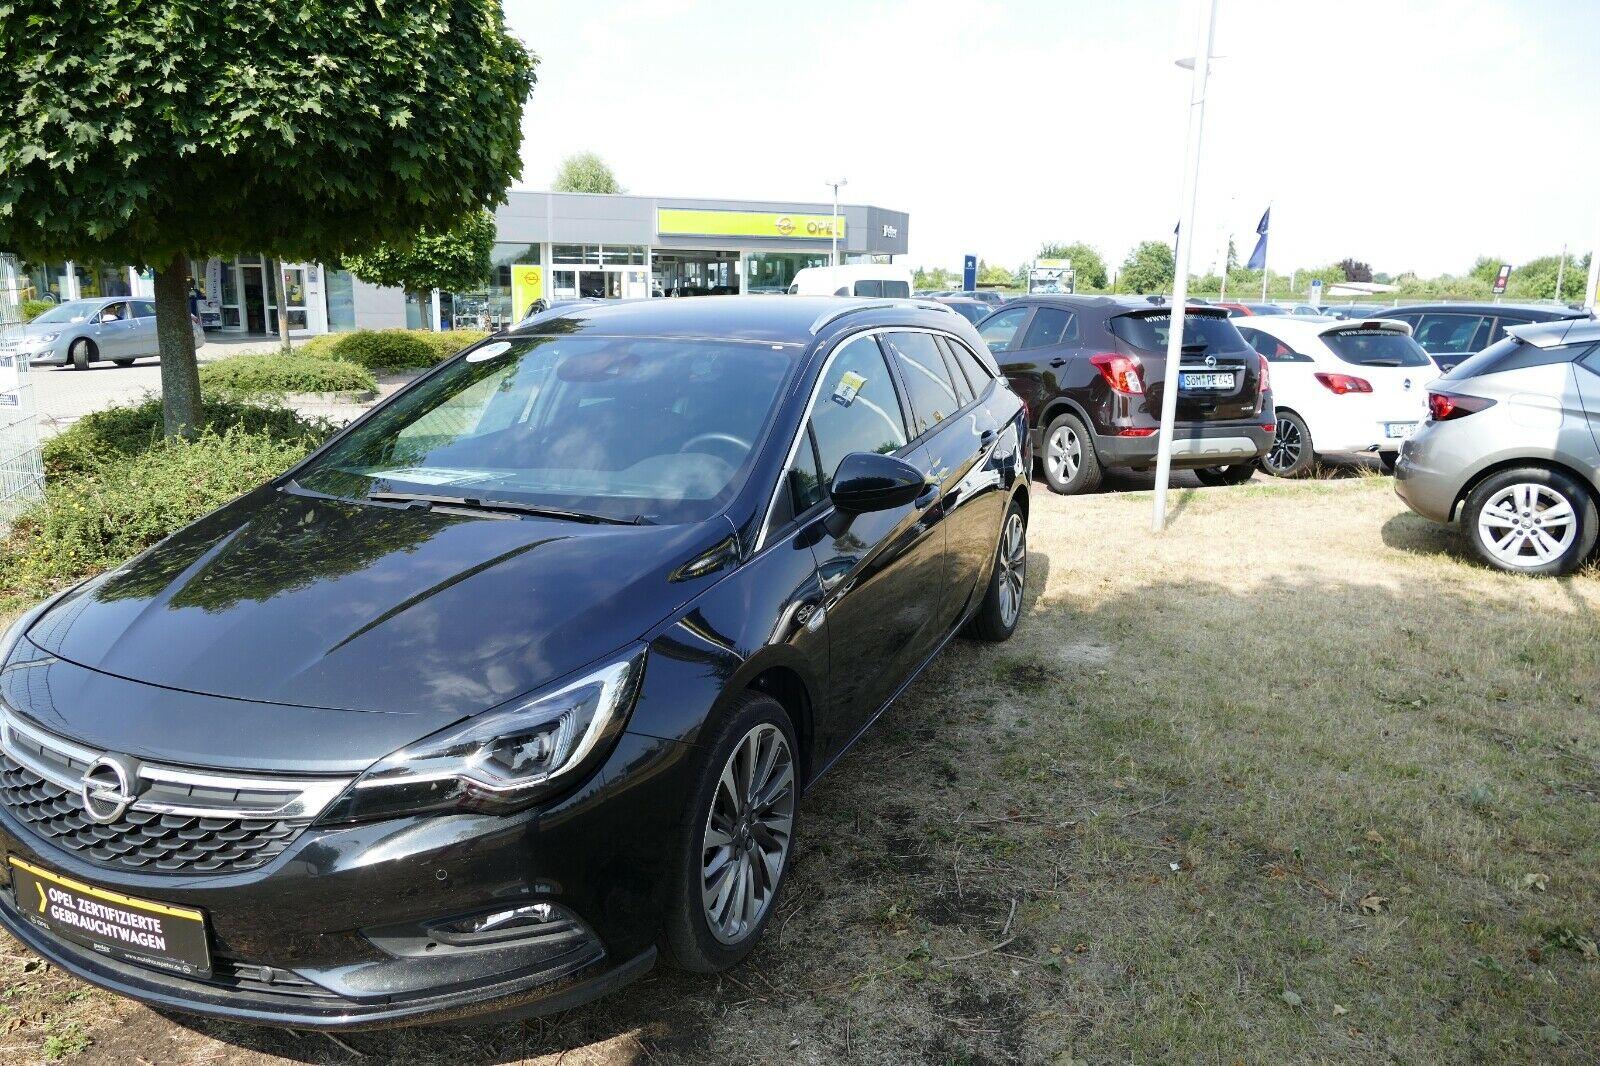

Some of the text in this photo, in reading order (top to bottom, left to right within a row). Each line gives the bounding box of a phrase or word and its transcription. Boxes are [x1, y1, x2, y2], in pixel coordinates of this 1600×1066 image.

[1207, 373, 1217, 386] PE
[49, 888, 162, 933] OPEL ZERTIFIZIERTE
[51, 904, 166, 950] GEBRAUCHTWAGEN
